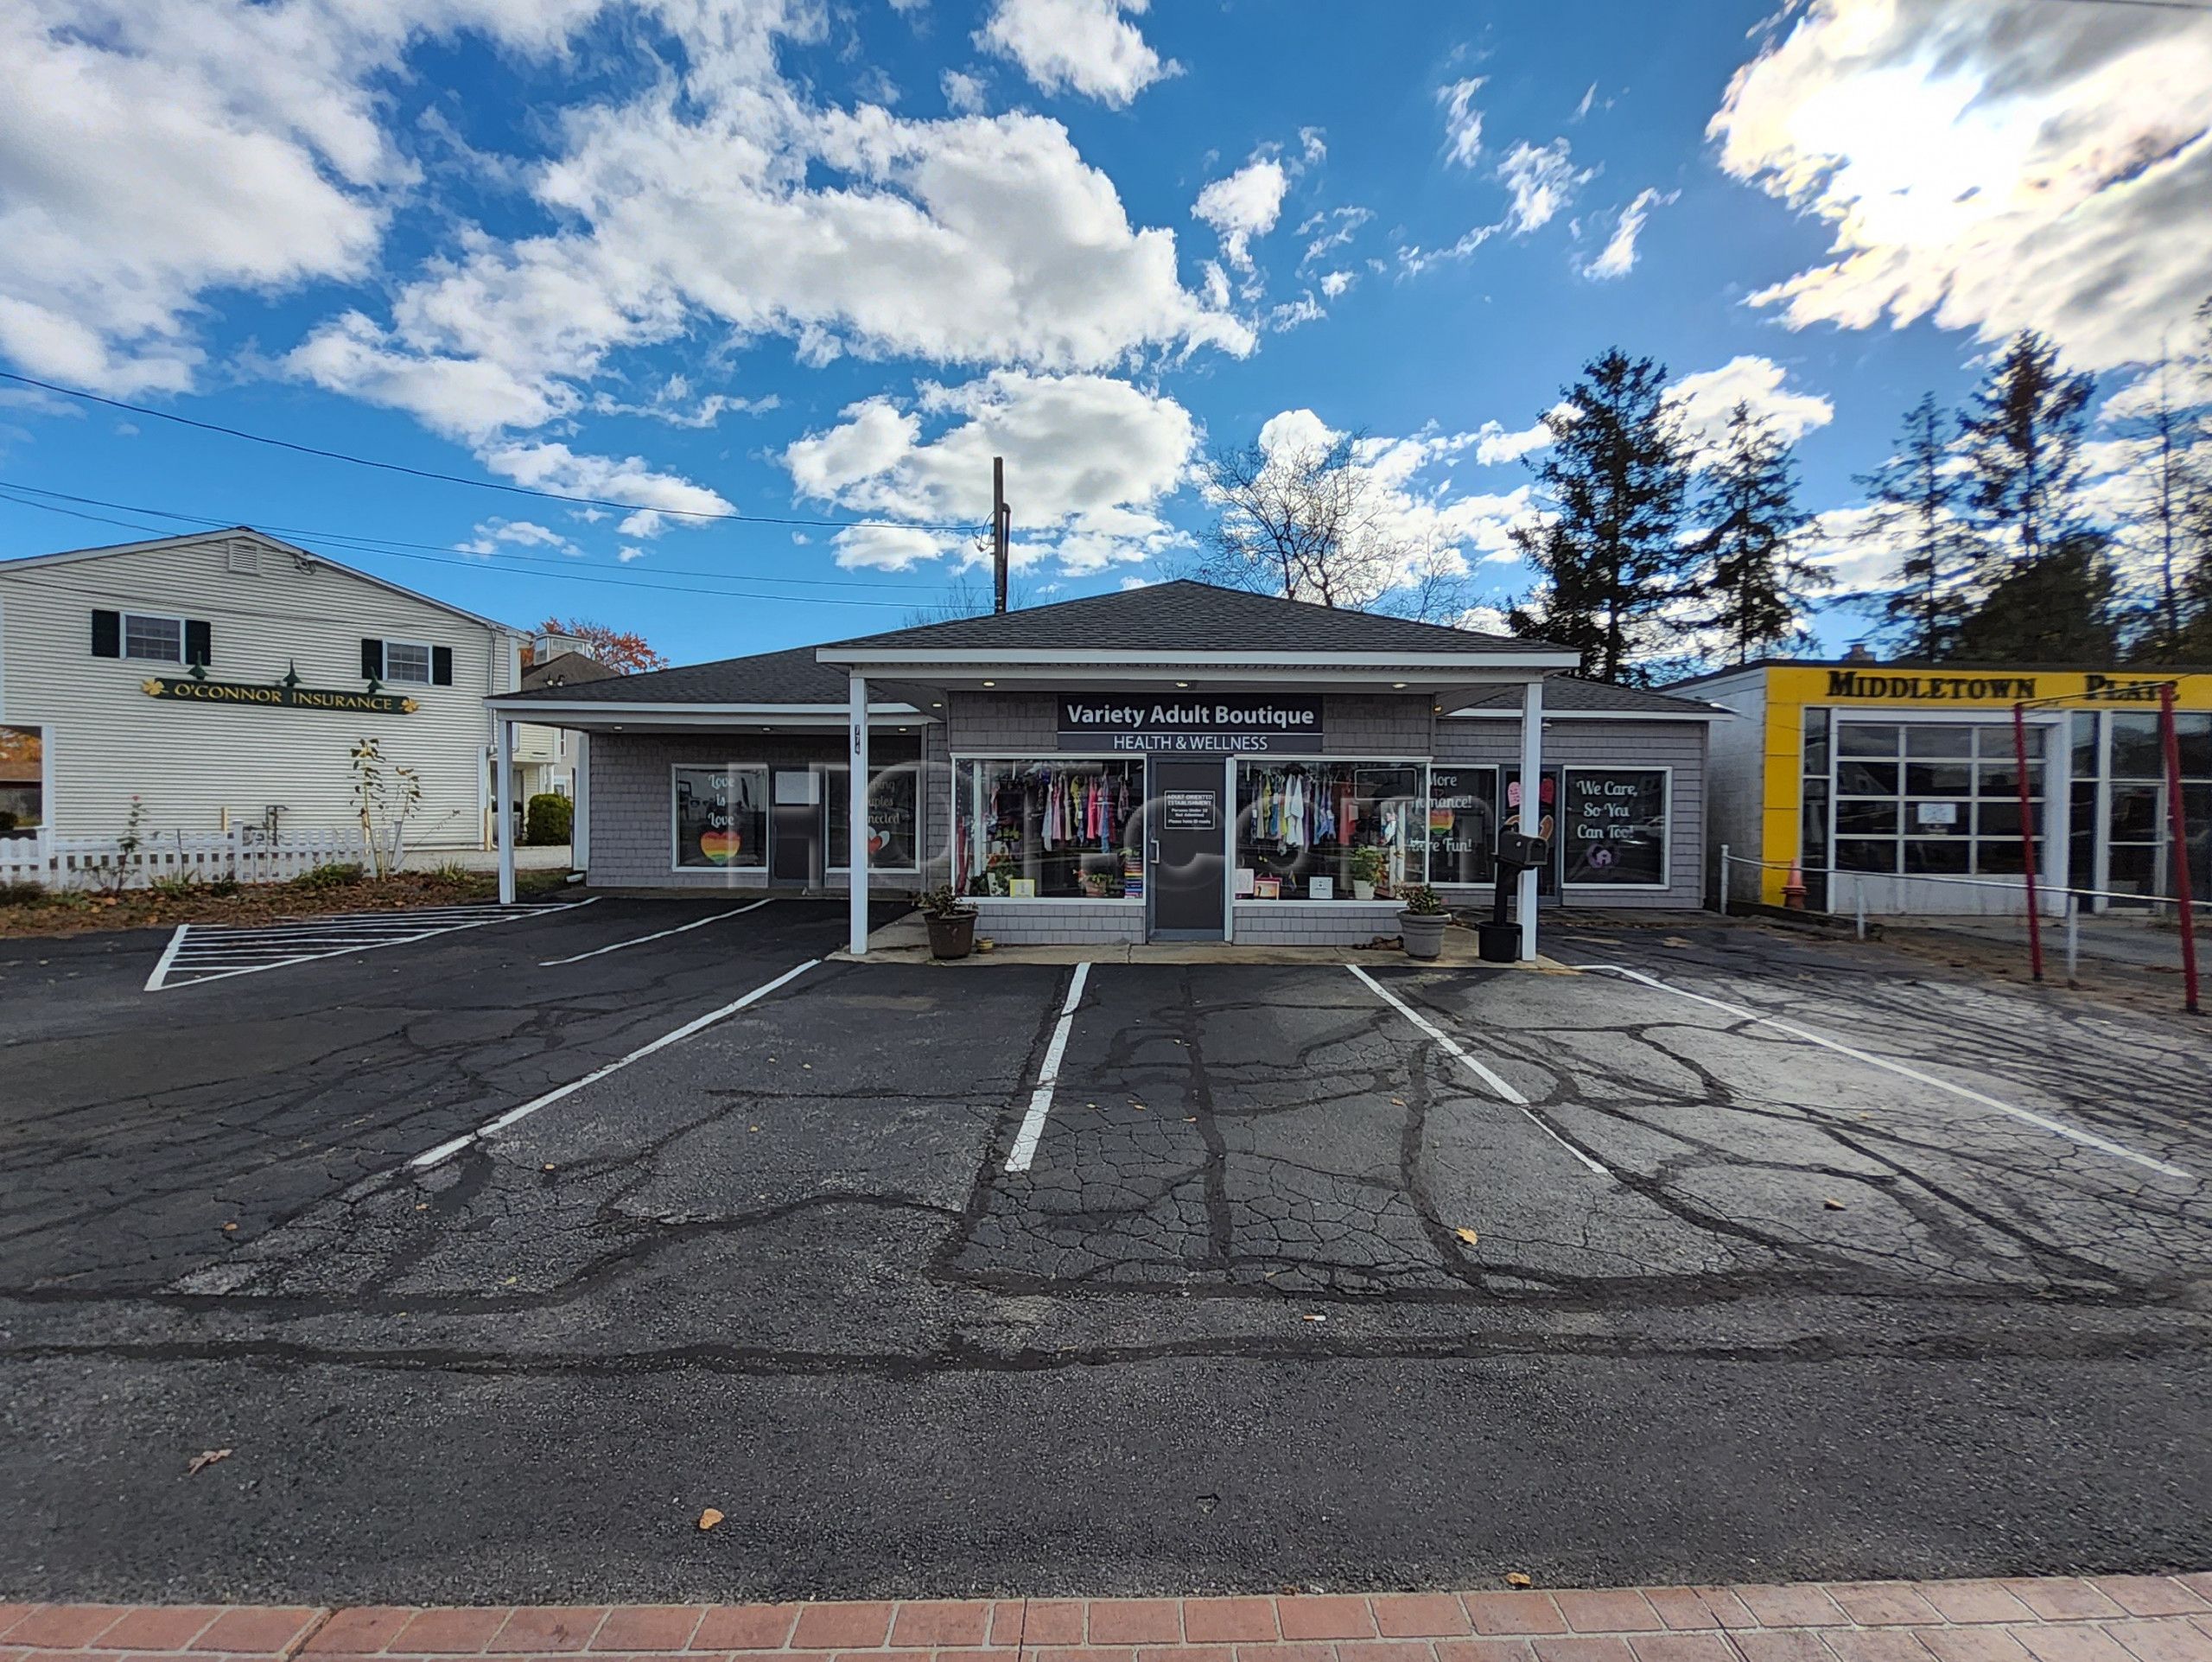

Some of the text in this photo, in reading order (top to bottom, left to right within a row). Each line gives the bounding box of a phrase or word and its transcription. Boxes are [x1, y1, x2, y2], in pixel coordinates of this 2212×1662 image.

[174, 683, 393, 710] O'CONNOR INSURANCE
[1066, 704, 1314, 729] Variety Adult Boutique
[1114, 735, 1268, 751] HEALTH & WELLNESS
[708, 774, 735, 791] Love
[1575, 780, 1638, 797] We Care,
[1409, 794, 1472, 811] Rmance!
[1583, 802, 1630, 818] So You
[707, 811, 735, 829] Love
[1577, 823, 1605, 839] Can
[1442, 837, 1472, 852] Fun!
